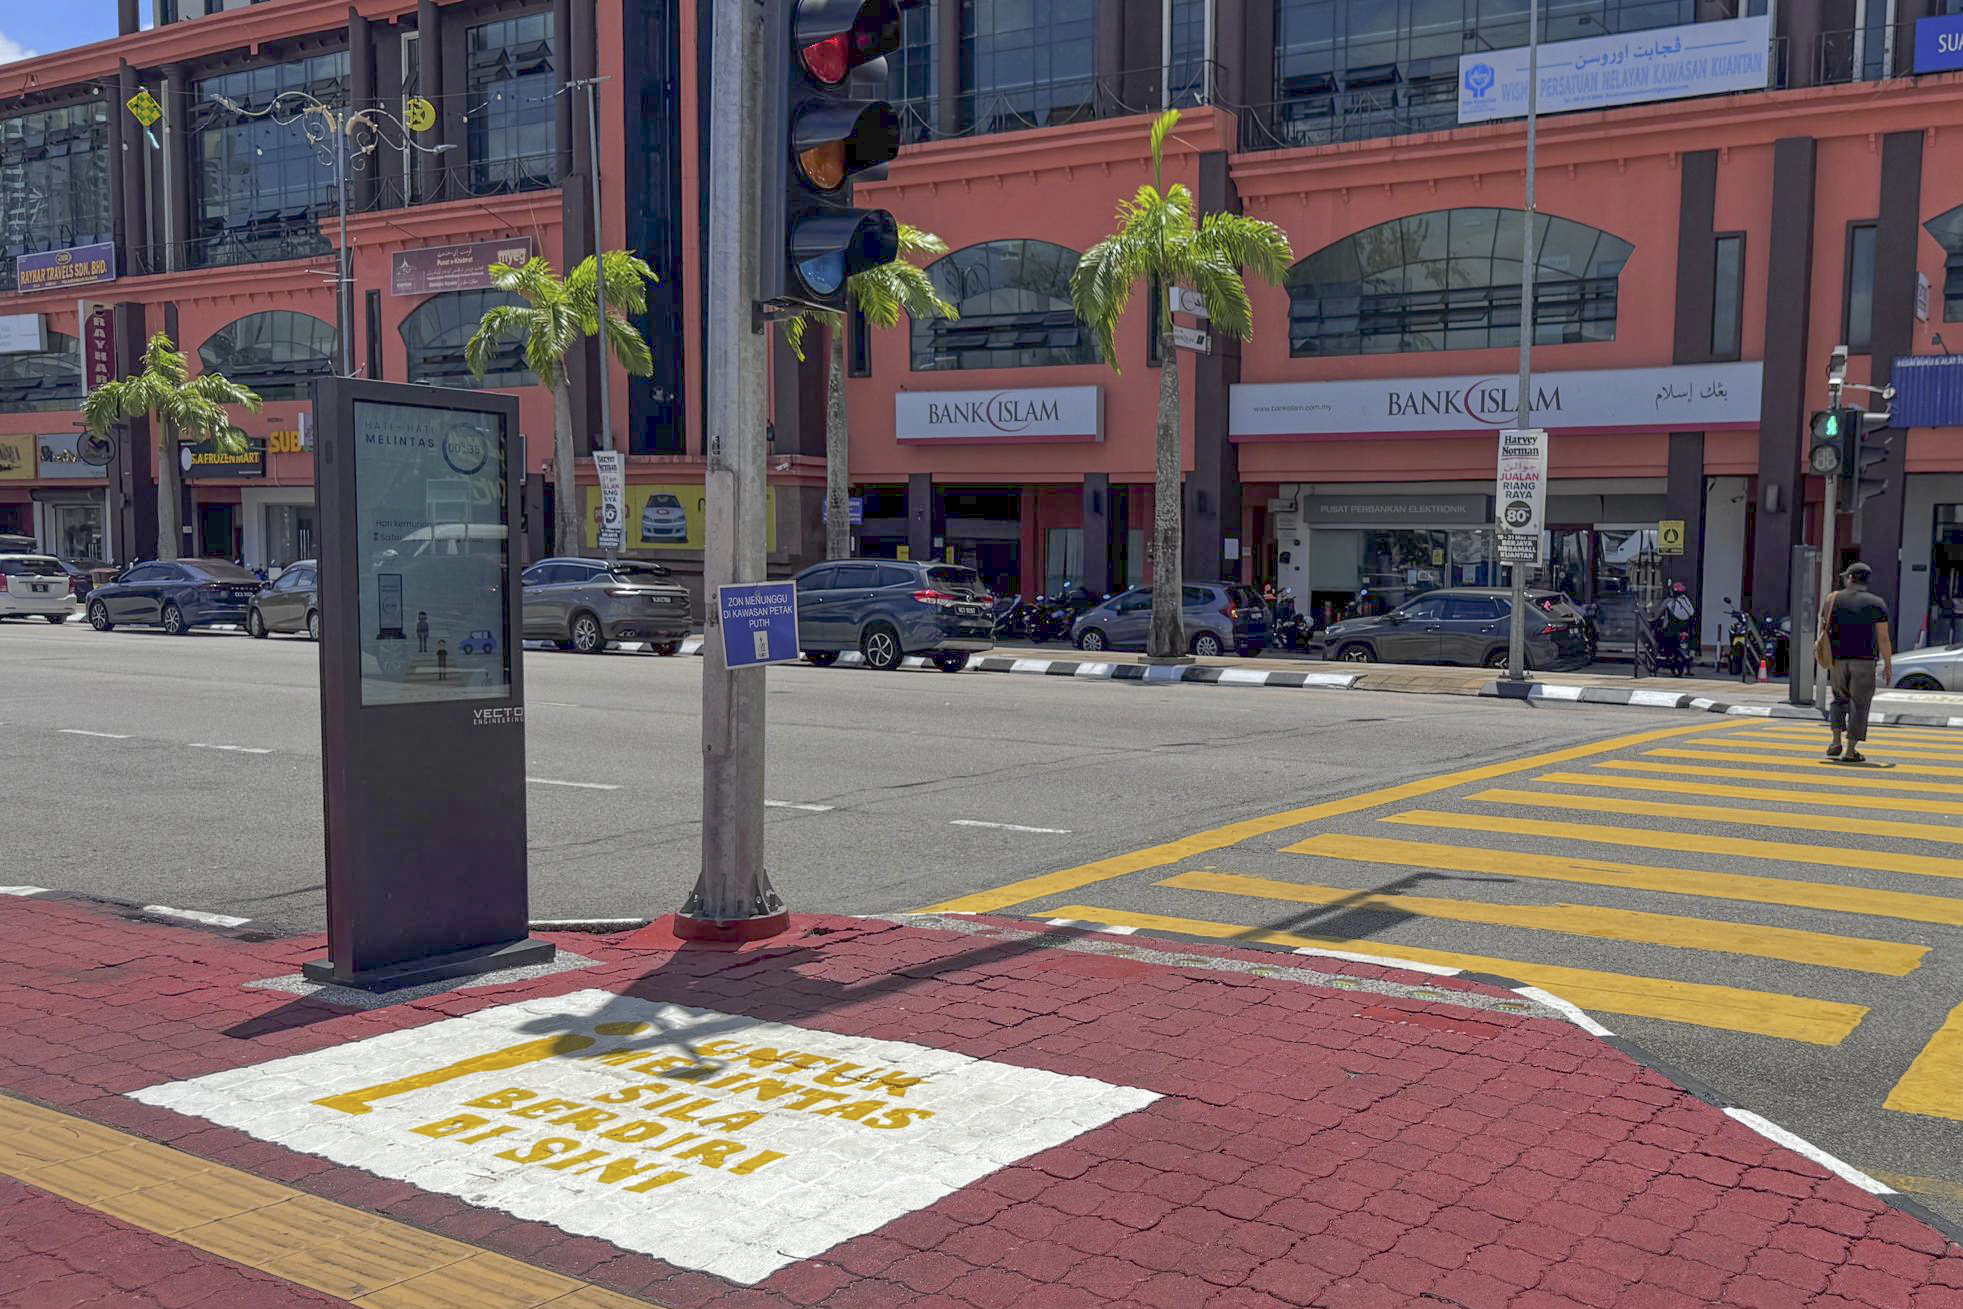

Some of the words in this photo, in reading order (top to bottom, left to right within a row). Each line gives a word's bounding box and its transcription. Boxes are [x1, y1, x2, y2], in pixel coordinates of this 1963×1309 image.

[1540, 73, 1598, 97] PERSATUAN
[1602, 66, 1649, 90] NELAYAN
[1653, 58, 1707, 84] KAWASAN
[1711, 52, 1762, 77] KUANTAN
[1388, 389, 1465, 416] BANK
[928, 401, 987, 424] BANK
[998, 399, 1061, 423] ISLAM
[365, 433, 435, 448] MELINTAS
[1504, 435, 1538, 446] Harvey
[1501, 446, 1539, 457] Norman
[1500, 472, 1539, 481] JUALAN
[1503, 481, 1536, 490] RIANG
[1505, 490, 1533, 499] RAYA
[1320, 504, 1349, 513] PUSAT
[1351, 504, 1406, 513] PERBANKAN
[1408, 503, 1466, 513] ELEKTRONIK
[1500, 551, 1534, 559] KUANTAN
[728, 597, 744, 607] ZON
[745, 594, 788, 606] MENUNGGU
[723, 610, 732, 619] DI
[732, 607, 768, 618] KAWASAN
[769, 605, 793, 616] PETAK
[749, 618, 770, 629] PUTIH
[697, 1039, 929, 1098] UNTUK
[576, 1047, 936, 1130] MELINTAS
[592, 1082, 770, 1133] SILA
[458, 1087, 789, 1176] BERDIRI
[407, 1113, 522, 1146] DI
[492, 1137, 693, 1194] SINI
